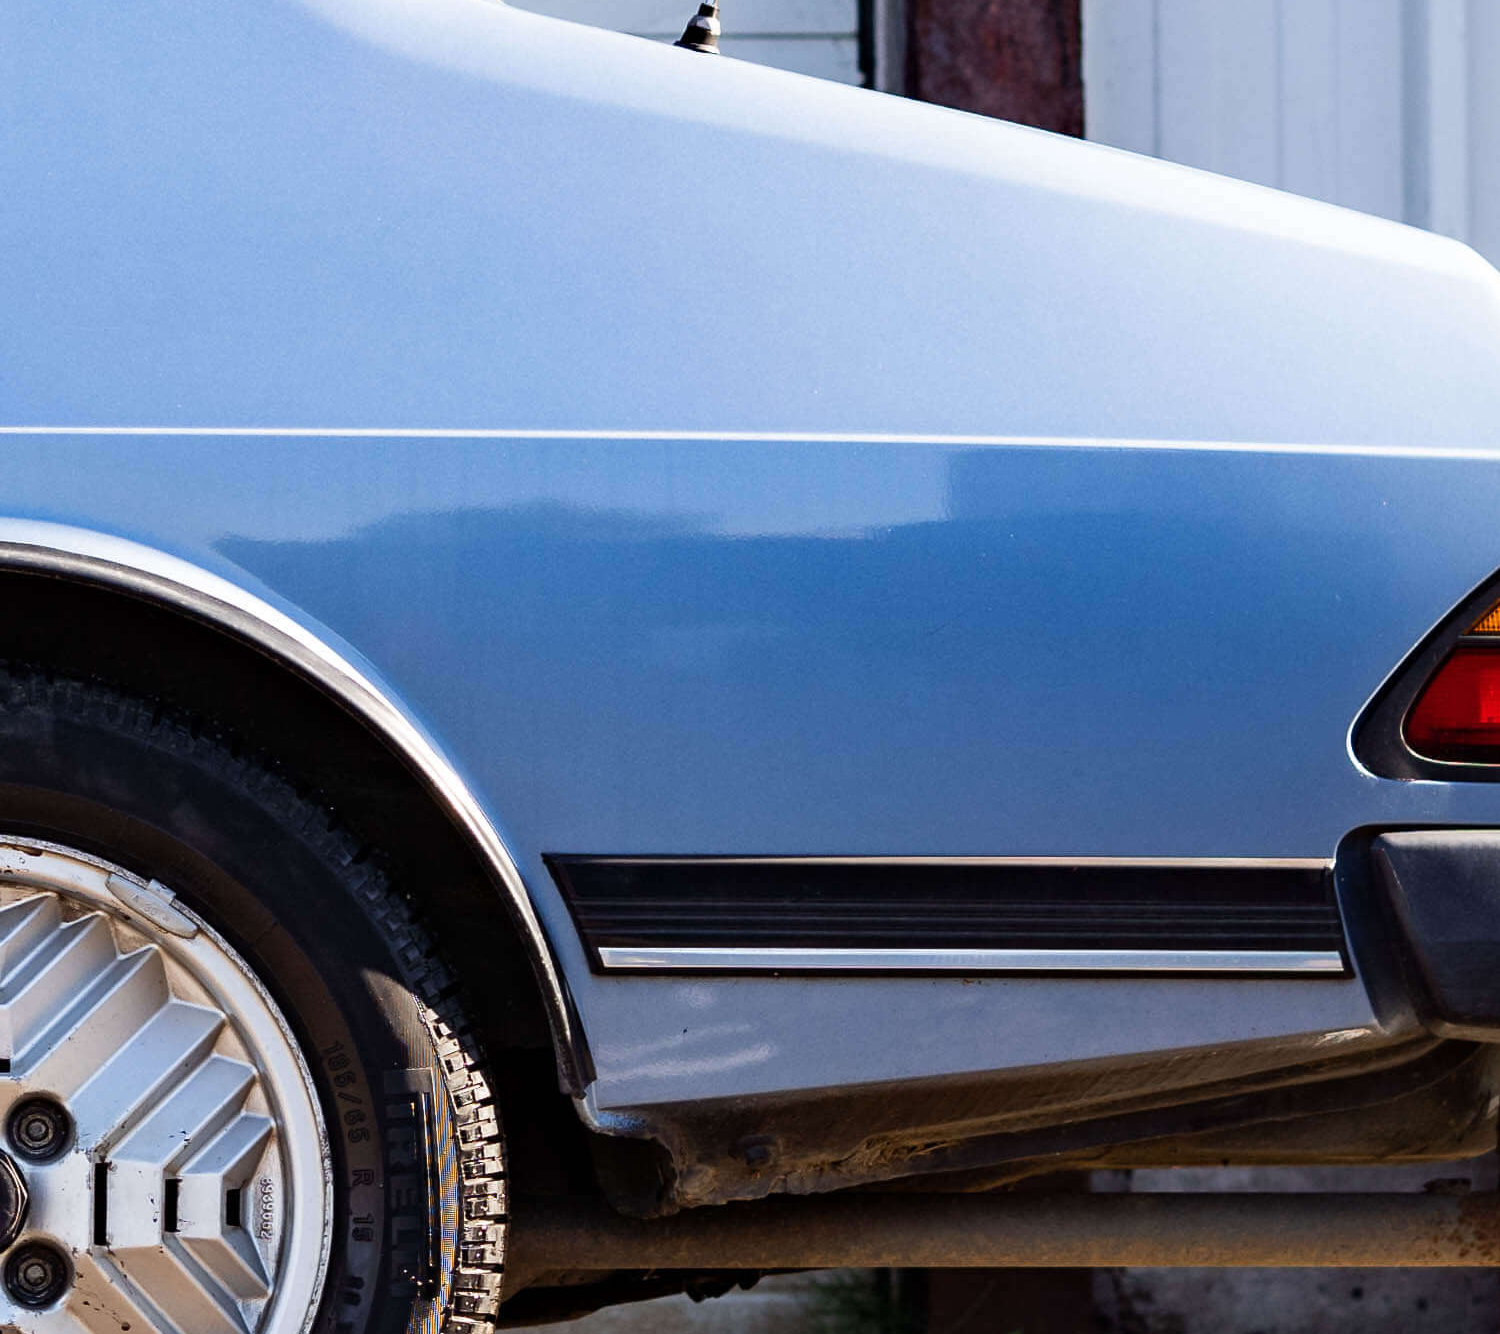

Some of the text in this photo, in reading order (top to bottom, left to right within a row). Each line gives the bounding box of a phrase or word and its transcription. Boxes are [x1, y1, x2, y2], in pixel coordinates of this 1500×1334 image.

[322, 1040, 371, 1144] 185/65
[351, 1169, 374, 1186] R
[351, 1213, 373, 1242] 15
